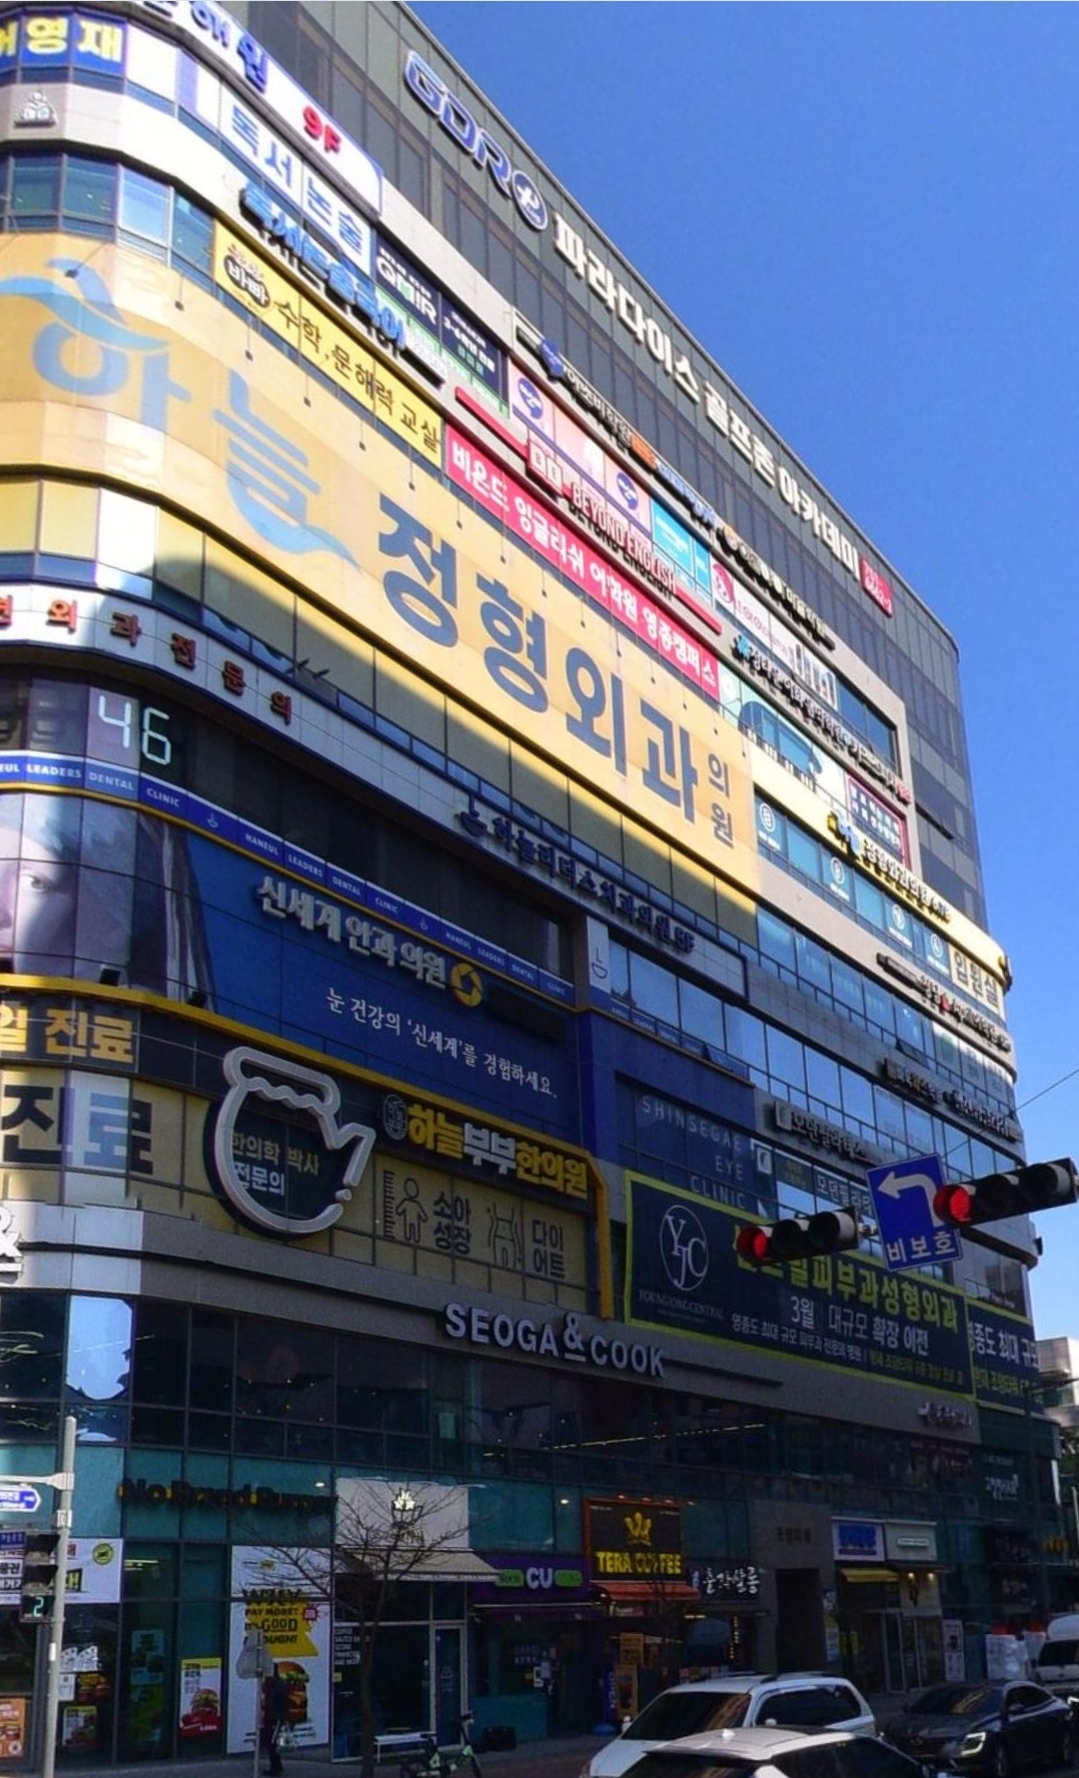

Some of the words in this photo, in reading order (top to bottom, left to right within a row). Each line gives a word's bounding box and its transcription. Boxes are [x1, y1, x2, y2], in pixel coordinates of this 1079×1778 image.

[405, 50, 514, 201] GDR
[555, 211, 700, 405] 파라다이스
[704, 380, 777, 488] 골프존
[778, 465, 861, 582] 아카데미
[401, 401, 440, 454] 교실
[453, 445, 511, 513] 비온드
[515, 498, 585, 578] 잉글리쉬
[571, 483, 628, 541] BEYOND
[628, 531, 677, 596] ENGLISH
[26, 763, 82, 779] LEADERS
[88, 771, 136, 791] DENTAL
[146, 787, 182, 809] CLINIC
[286, 853, 324, 878] LEADERS
[331, 874, 362, 897] DENTAL
[373, 895, 400, 916] CLINIC
[492, 812, 673, 943] 하늘리더스치과의원
[257, 874, 342, 948] 신세계
[345, 916, 397, 967] 안과
[399, 945, 448, 991] 의원
[45, 1008, 135, 1065] 진료
[326, 987, 346, 1015] 눈
[350, 996, 402, 1037] 건강의
[483, 1052, 558, 1100] 경험하세요.
[642, 1095, 743, 1153] SHINSEGAE
[286, 1146, 320, 1178] 박사
[408, 1103, 588, 1200] 하늘부부한의원
[714, 1154, 744, 1182] EYE
[433, 1189, 472, 1227] 소아
[690, 1175, 747, 1210] CLINIC
[432, 1219, 472, 1257] 성장
[531, 1217, 565, 1253] 다이
[886, 1234, 957, 1263] 비보호
[532, 1247, 565, 1280] 어트
[446, 1302, 561, 1359] SEOGA
[563, 1309, 587, 1362] &
[588, 1336, 665, 1378] COOK
[788, 1294, 816, 1331] 3월
[828, 1303, 868, 1341] 대규모
[904, 1324, 931, 1357] 이전
[526, 1567, 553, 1589] CU
[596, 1550, 631, 1573] TERA
[32, 1596, 45, 1618] 2
[261, 1617, 298, 1633] GOOD
